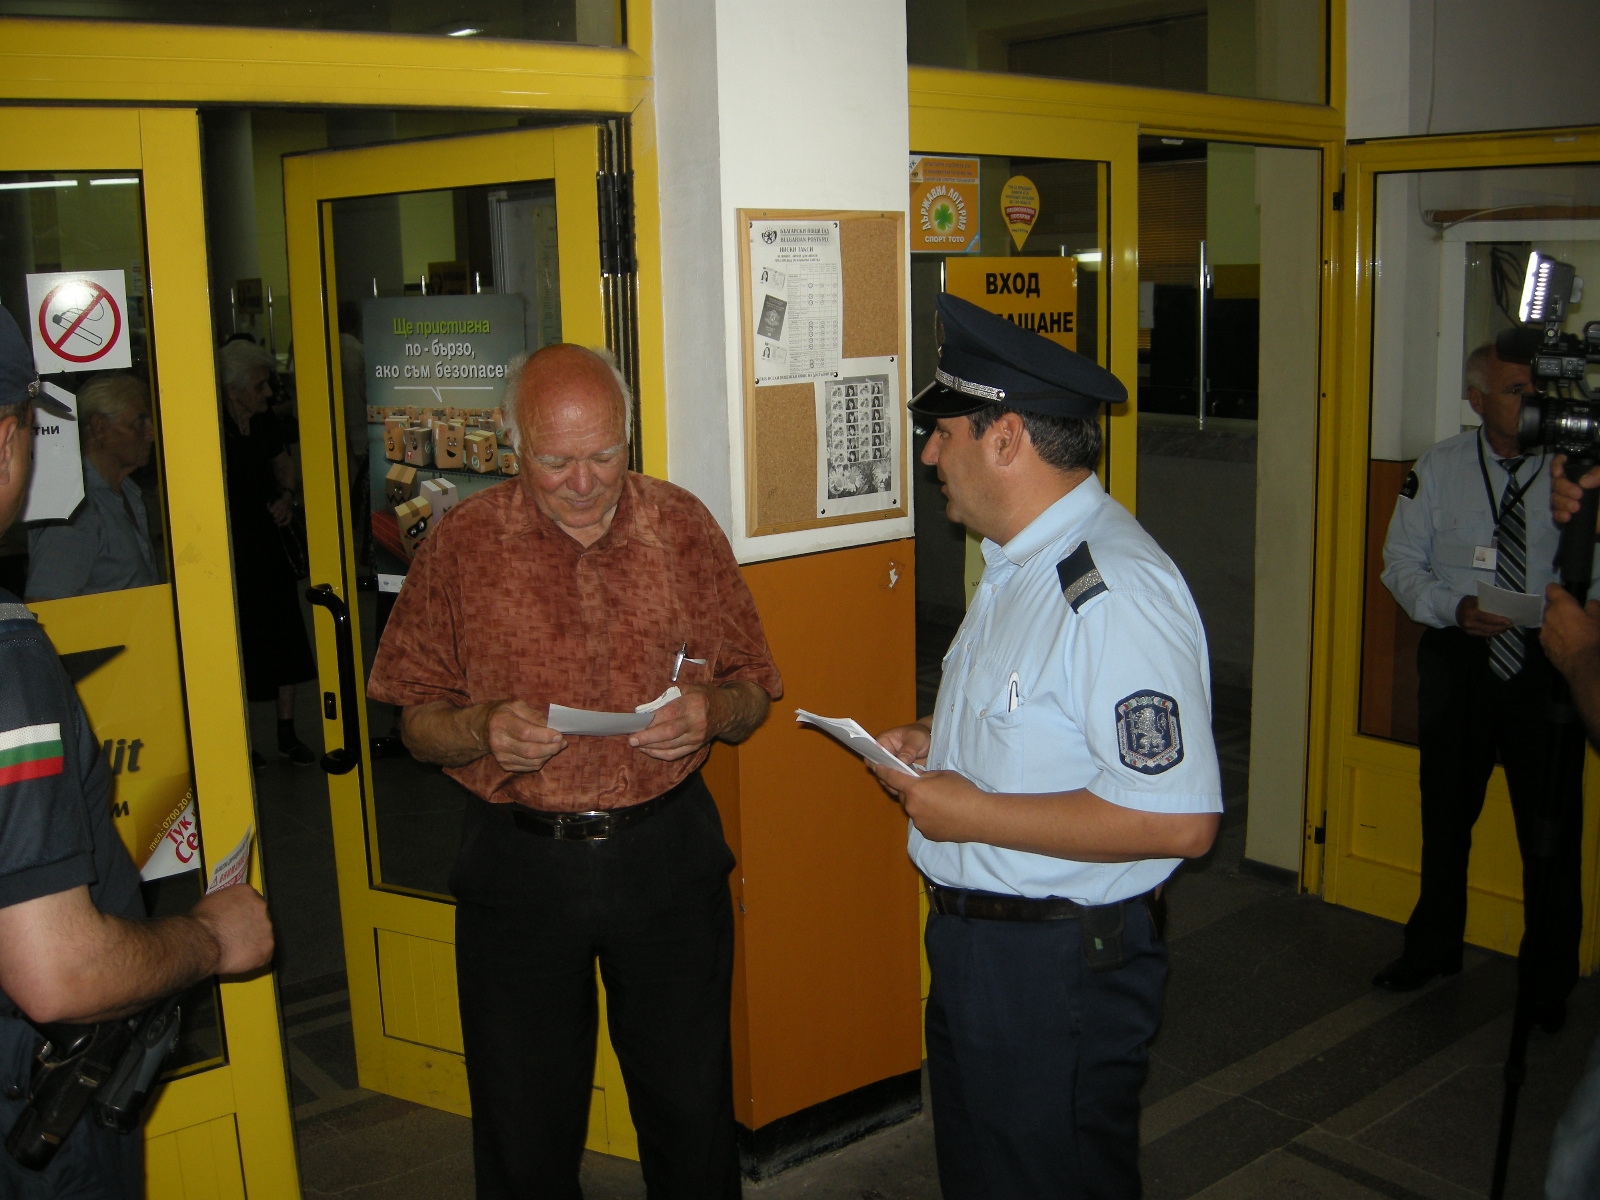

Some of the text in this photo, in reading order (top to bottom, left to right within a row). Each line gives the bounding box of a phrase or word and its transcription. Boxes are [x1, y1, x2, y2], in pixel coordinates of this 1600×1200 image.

[920, 185, 967, 231] ДЪРЖАВНА ЛОТАРИЯ
[924, 235, 946, 243] СПОРТ
[948, 235, 965, 243] ТОТО
[985, 272, 1041, 298] ВХОД
[393, 317, 490, 339] Ще пристигна
[375, 364, 401, 379] ако
[404, 364, 431, 379] съм
[162, 808, 180, 829] 0700
[177, 799, 188, 811] 20
[166, 815, 193, 845] Тук
[175, 832, 199, 864] Се
